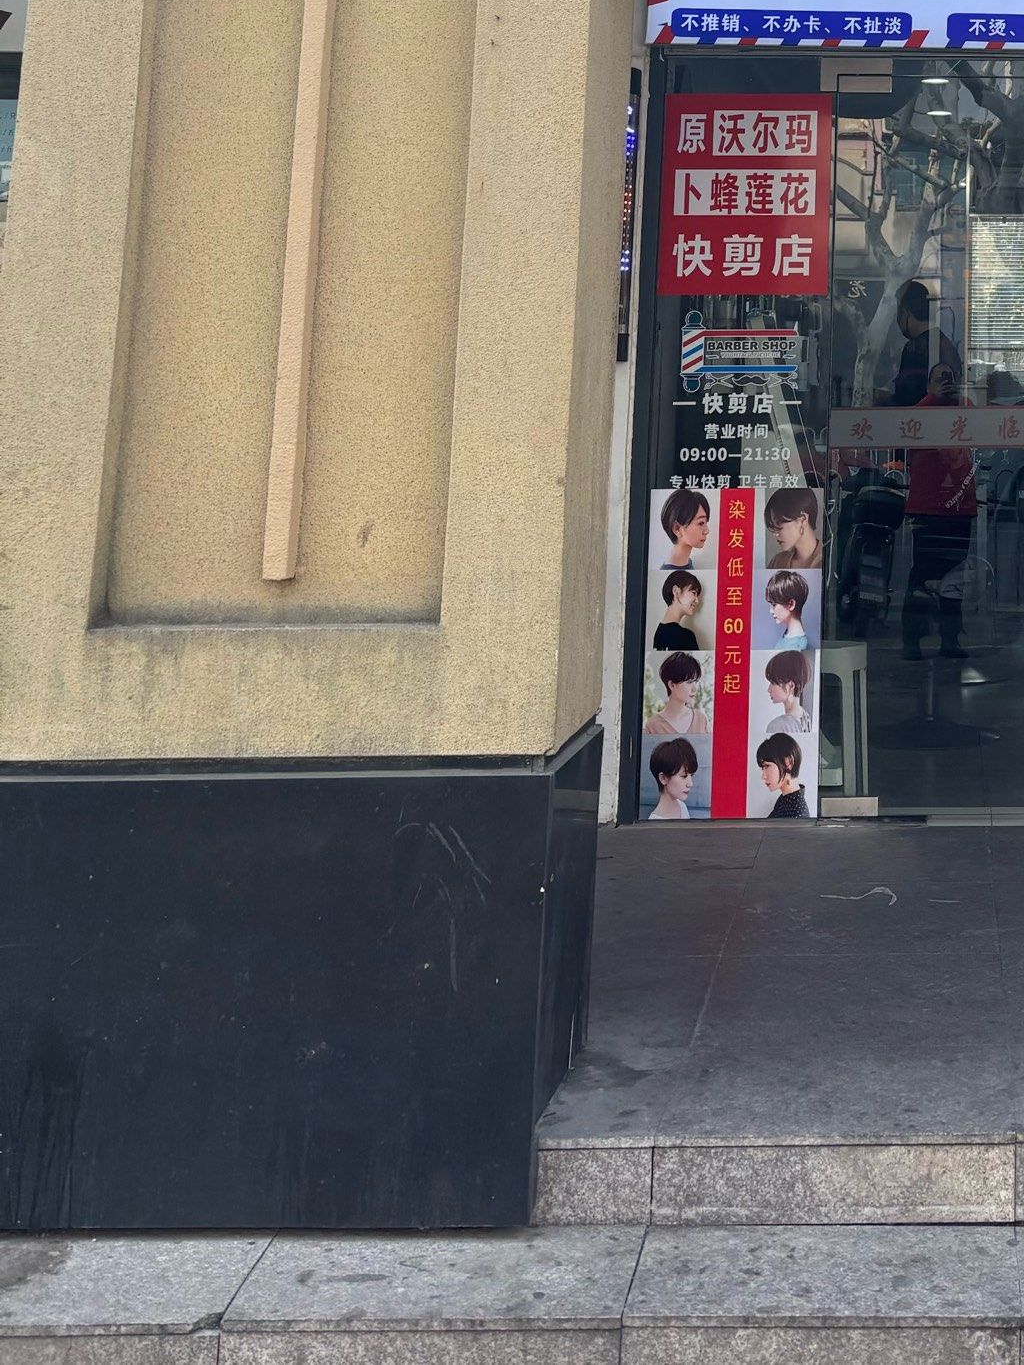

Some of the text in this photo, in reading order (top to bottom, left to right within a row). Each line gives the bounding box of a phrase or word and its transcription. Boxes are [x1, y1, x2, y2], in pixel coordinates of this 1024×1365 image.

[680, 13, 902, 35] 不推销、不办卡、不扯淡
[677, 110, 816, 156] 原沃尔玛
[680, 171, 811, 216] 卜蜂莲花
[672, 232, 814, 278] 快剪店
[707, 340, 798, 351] BARBER SHOP
[702, 392, 774, 415] 快剪店
[704, 423, 769, 440] 营业时间
[851, 415, 1021, 441] 欢迎光临
[669, 474, 799, 489] 专业快剪 卫生高效
[722, 499, 747, 695] 染发低至60元起
